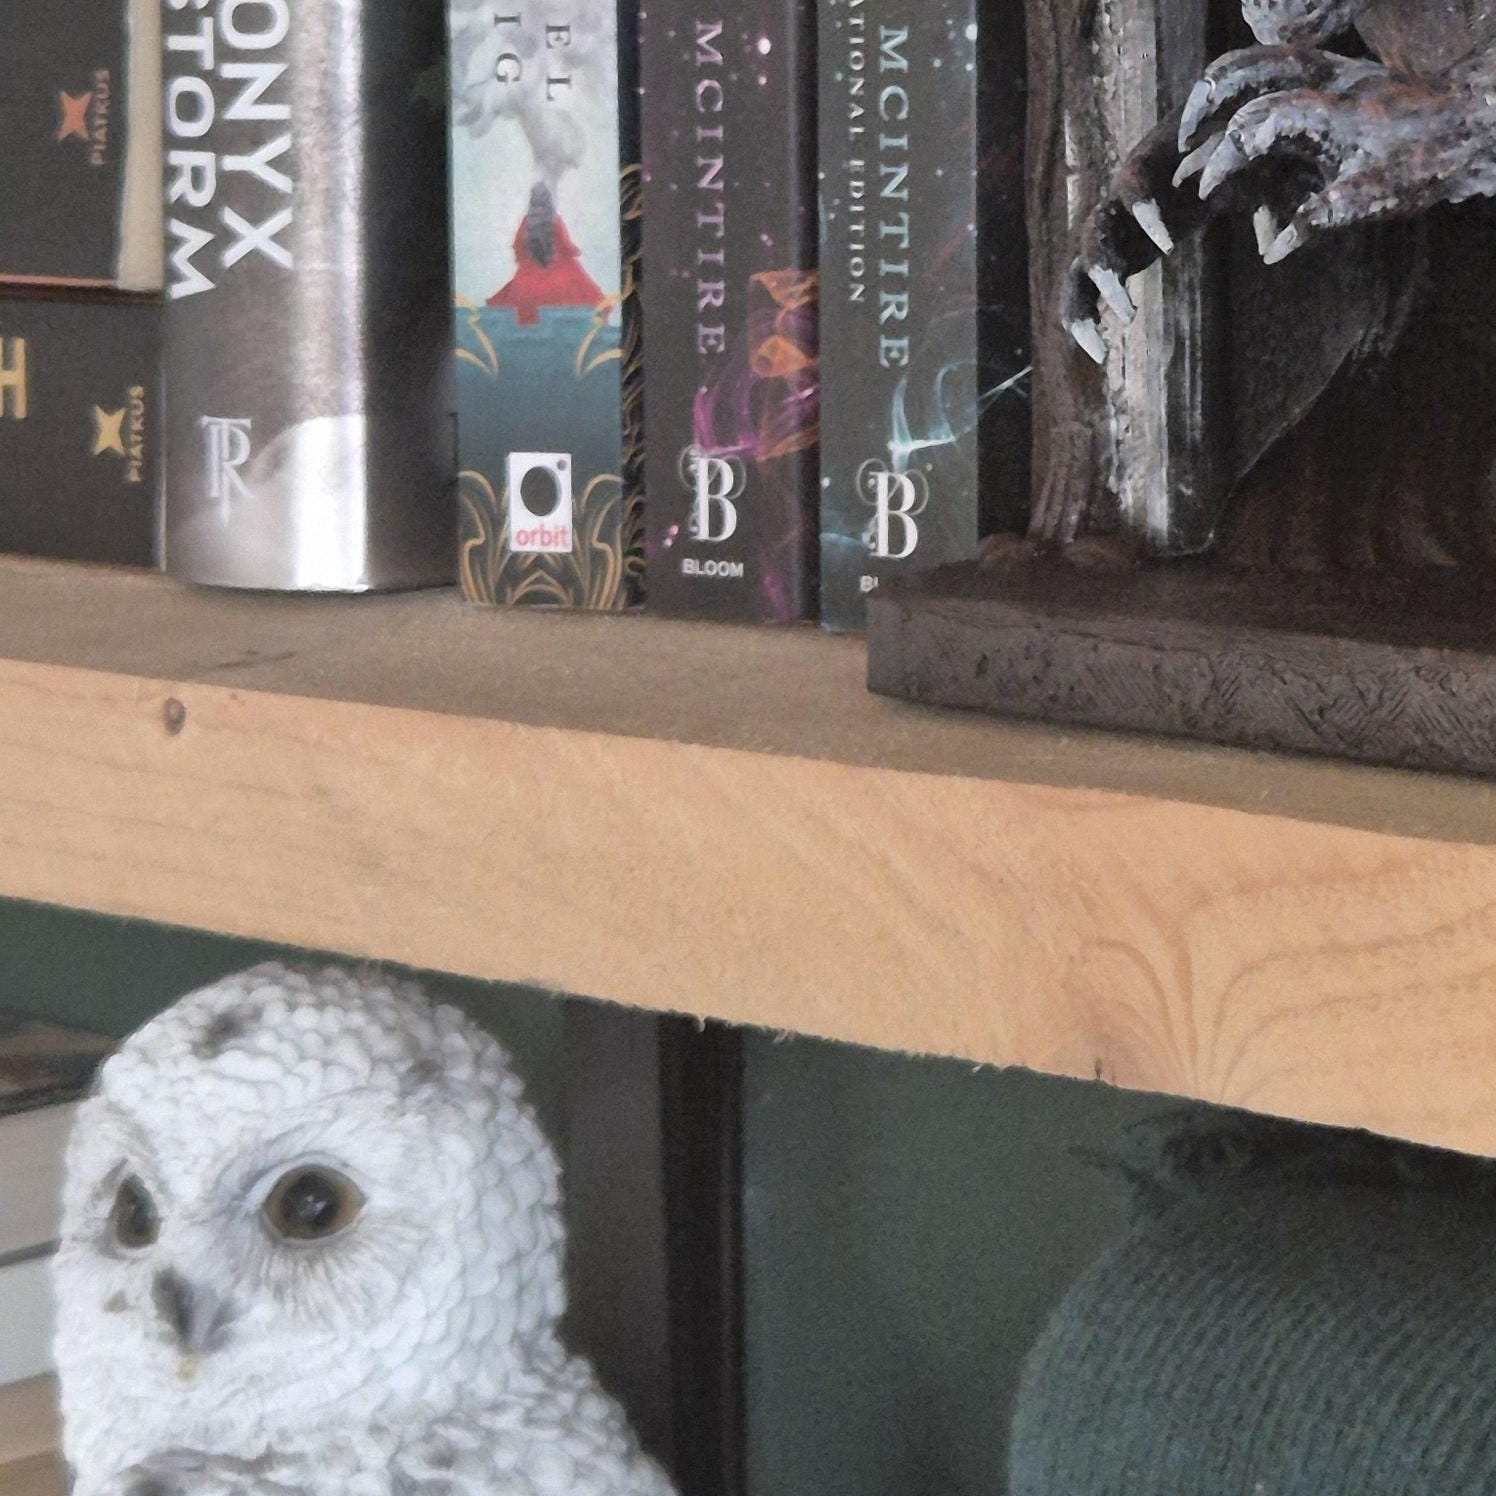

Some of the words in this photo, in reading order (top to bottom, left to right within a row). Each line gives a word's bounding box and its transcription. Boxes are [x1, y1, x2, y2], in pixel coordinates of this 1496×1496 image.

[89, 68, 111, 166] PIATKUS
[692, 19, 727, 357] MCINTIRE
[848, 157, 867, 304] EDITION
[876, 25, 912, 371] MCINTIRE
[123, 384, 145, 484] PIATKUS
[515, 524, 570, 549] orbit
[681, 557, 745, 579] BLOOM
